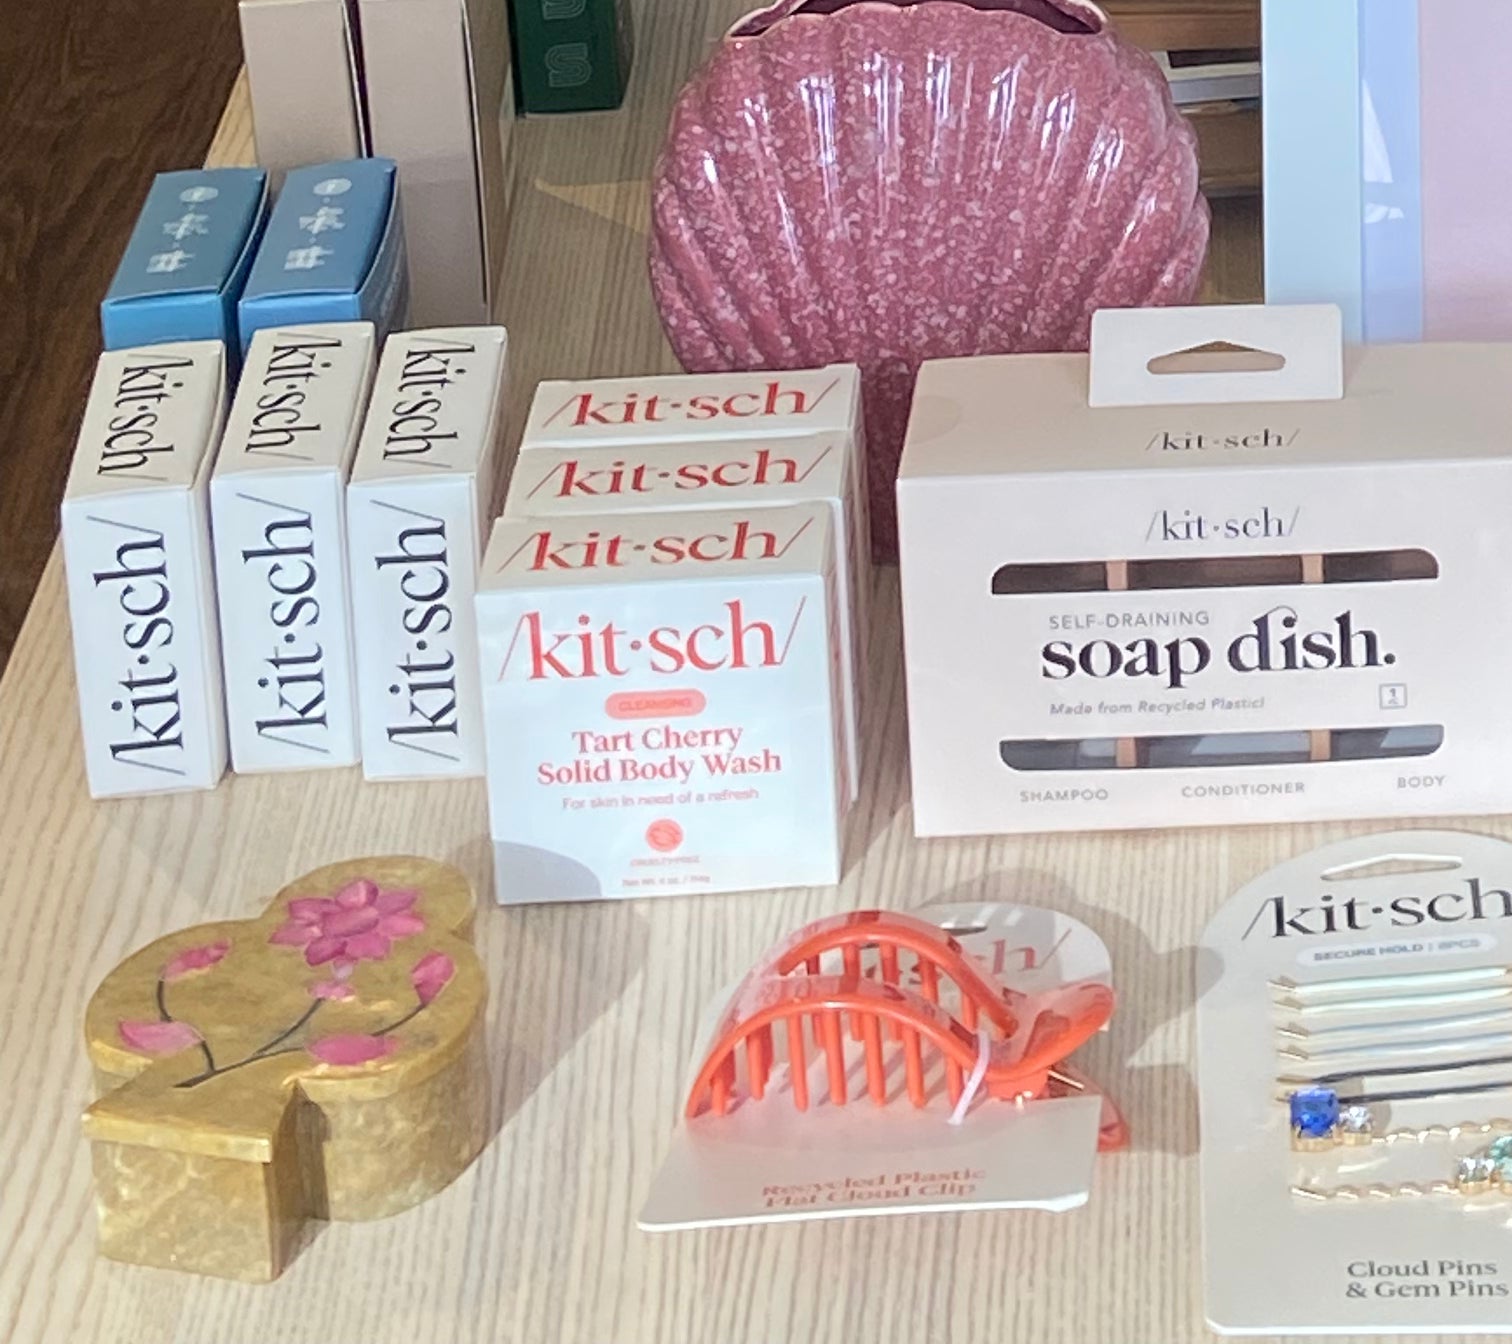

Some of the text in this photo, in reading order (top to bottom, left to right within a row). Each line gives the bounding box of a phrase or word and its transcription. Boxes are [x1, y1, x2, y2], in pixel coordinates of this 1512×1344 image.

[1048, 610, 1210, 631] SELF-DRAINING
[1041, 605, 1397, 689] soap dish.
[1049, 702, 1093, 716] Made
[1097, 700, 1135, 715] from
[1137, 697, 1207, 715] Recycled
[571, 725, 744, 754] Tart Cherry
[537, 749, 782, 786] Solid Body Wash
[562, 796, 586, 810] For
[590, 795, 618, 809] skin
[621, 794, 635, 807] in
[637, 792, 675, 806] need
[677, 790, 693, 803] of
[1019, 775, 1446, 803] SHAMPOO CONDITIONER BODY
[1314, 946, 1376, 962] SECURE
[1379, 943, 1424, 956] HOLD
[762, 1167, 987, 1197] Recycled Plastic
[827, 1185, 908, 1206] Cloud
[912, 1181, 977, 1200] Clip
[1347, 1259, 1498, 1278] Cloud Pins
[1345, 1279, 1510, 1298] & Gem Pins
